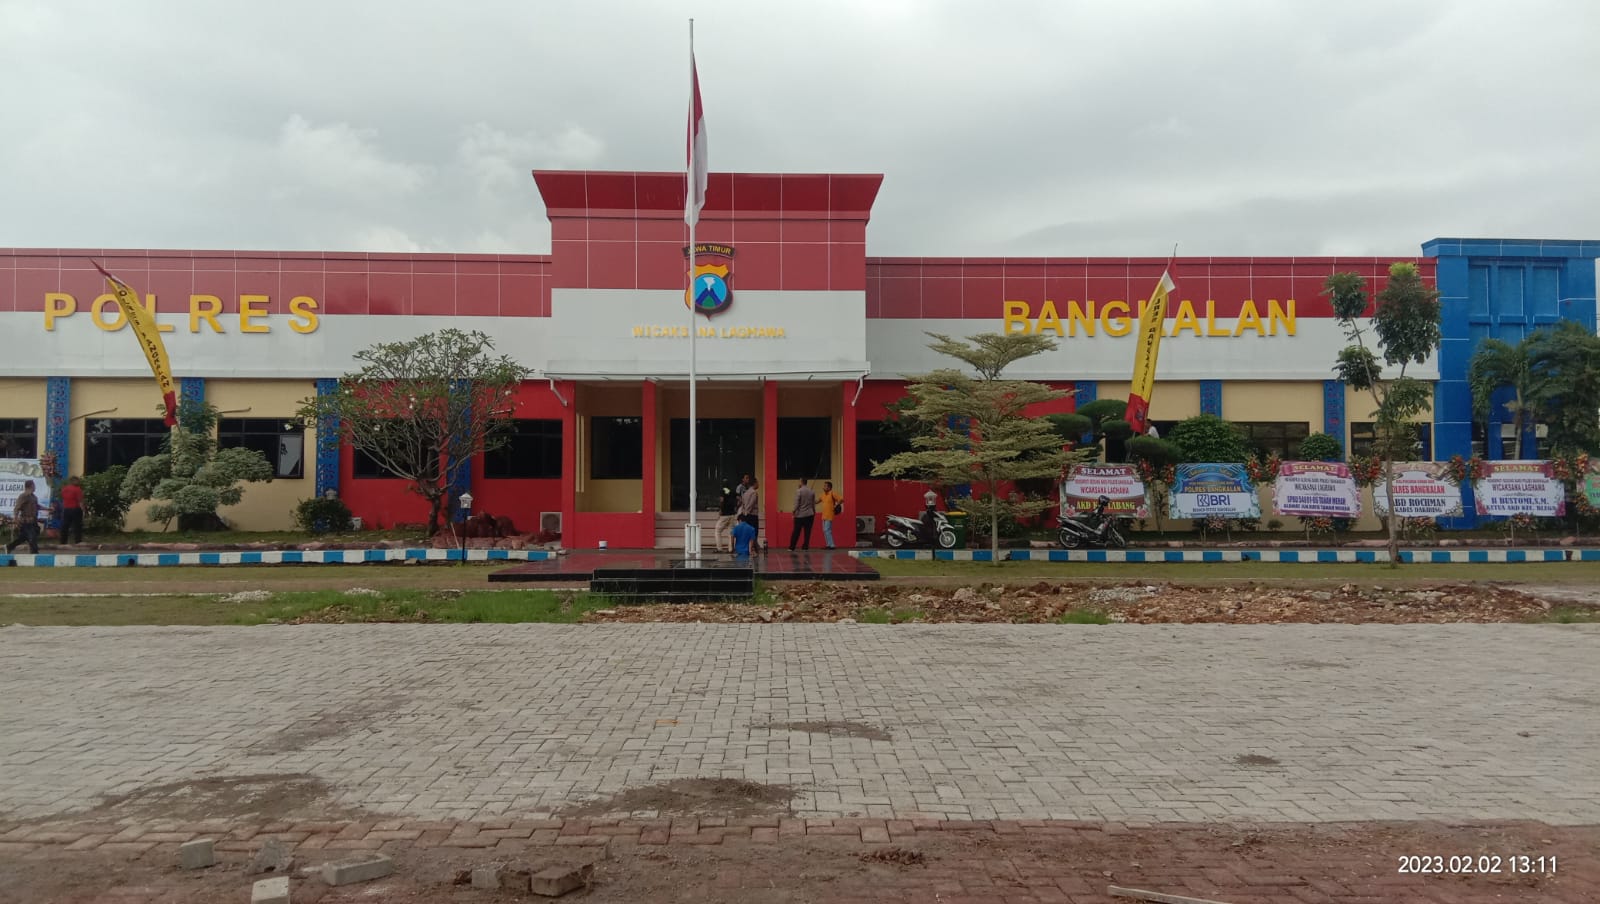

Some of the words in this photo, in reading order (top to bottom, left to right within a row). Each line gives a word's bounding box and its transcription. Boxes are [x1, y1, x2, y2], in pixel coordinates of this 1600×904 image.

[709, 246, 731, 255] TIMUR
[1081, 468, 1127, 476] SELAMAT
[1294, 464, 1336, 472] SELAMAT
[1210, 494, 1231, 506] BRI
[1408, 498, 1446, 506] ROCHMAN
